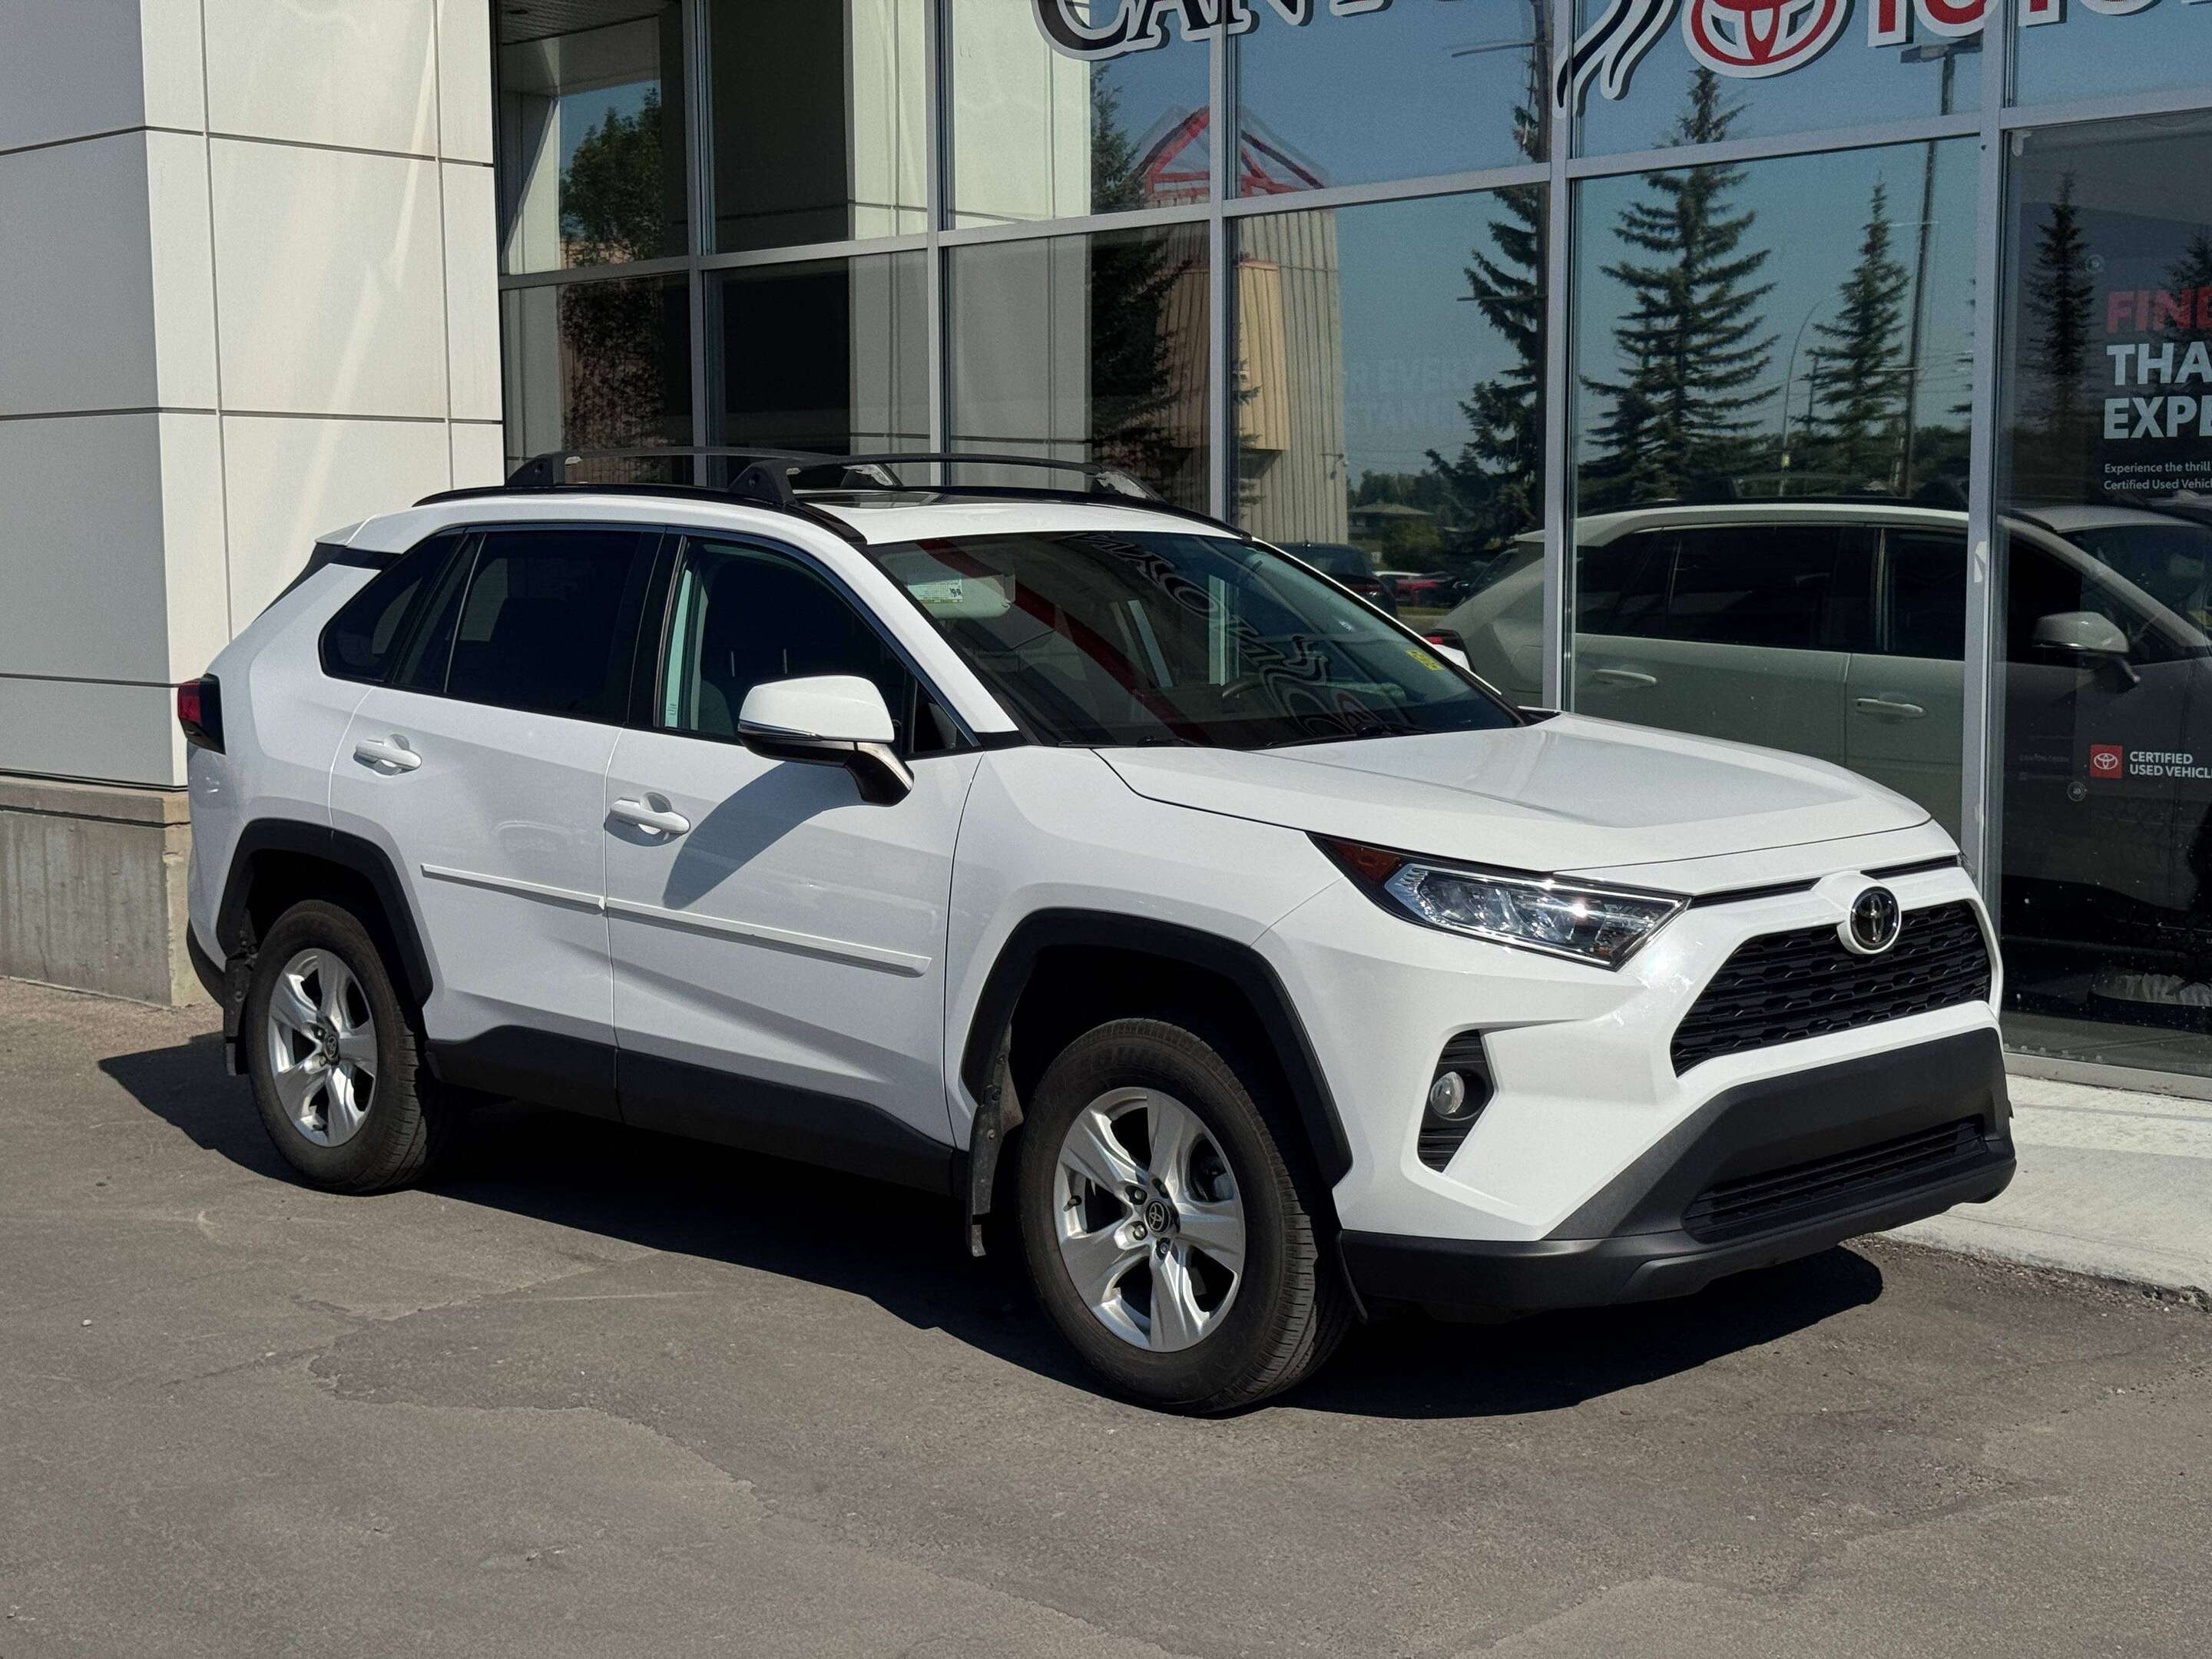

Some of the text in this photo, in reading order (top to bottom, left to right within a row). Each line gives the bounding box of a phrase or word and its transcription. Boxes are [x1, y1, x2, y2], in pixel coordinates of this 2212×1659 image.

[2104, 461, 2211, 475] Experience the thrill
[2104, 478, 2150, 490] Certified
[2152, 478, 2180, 489] Used
[2129, 751, 2194, 764] CERTIFIED
[2129, 764, 2212, 779] USED VEHICL
